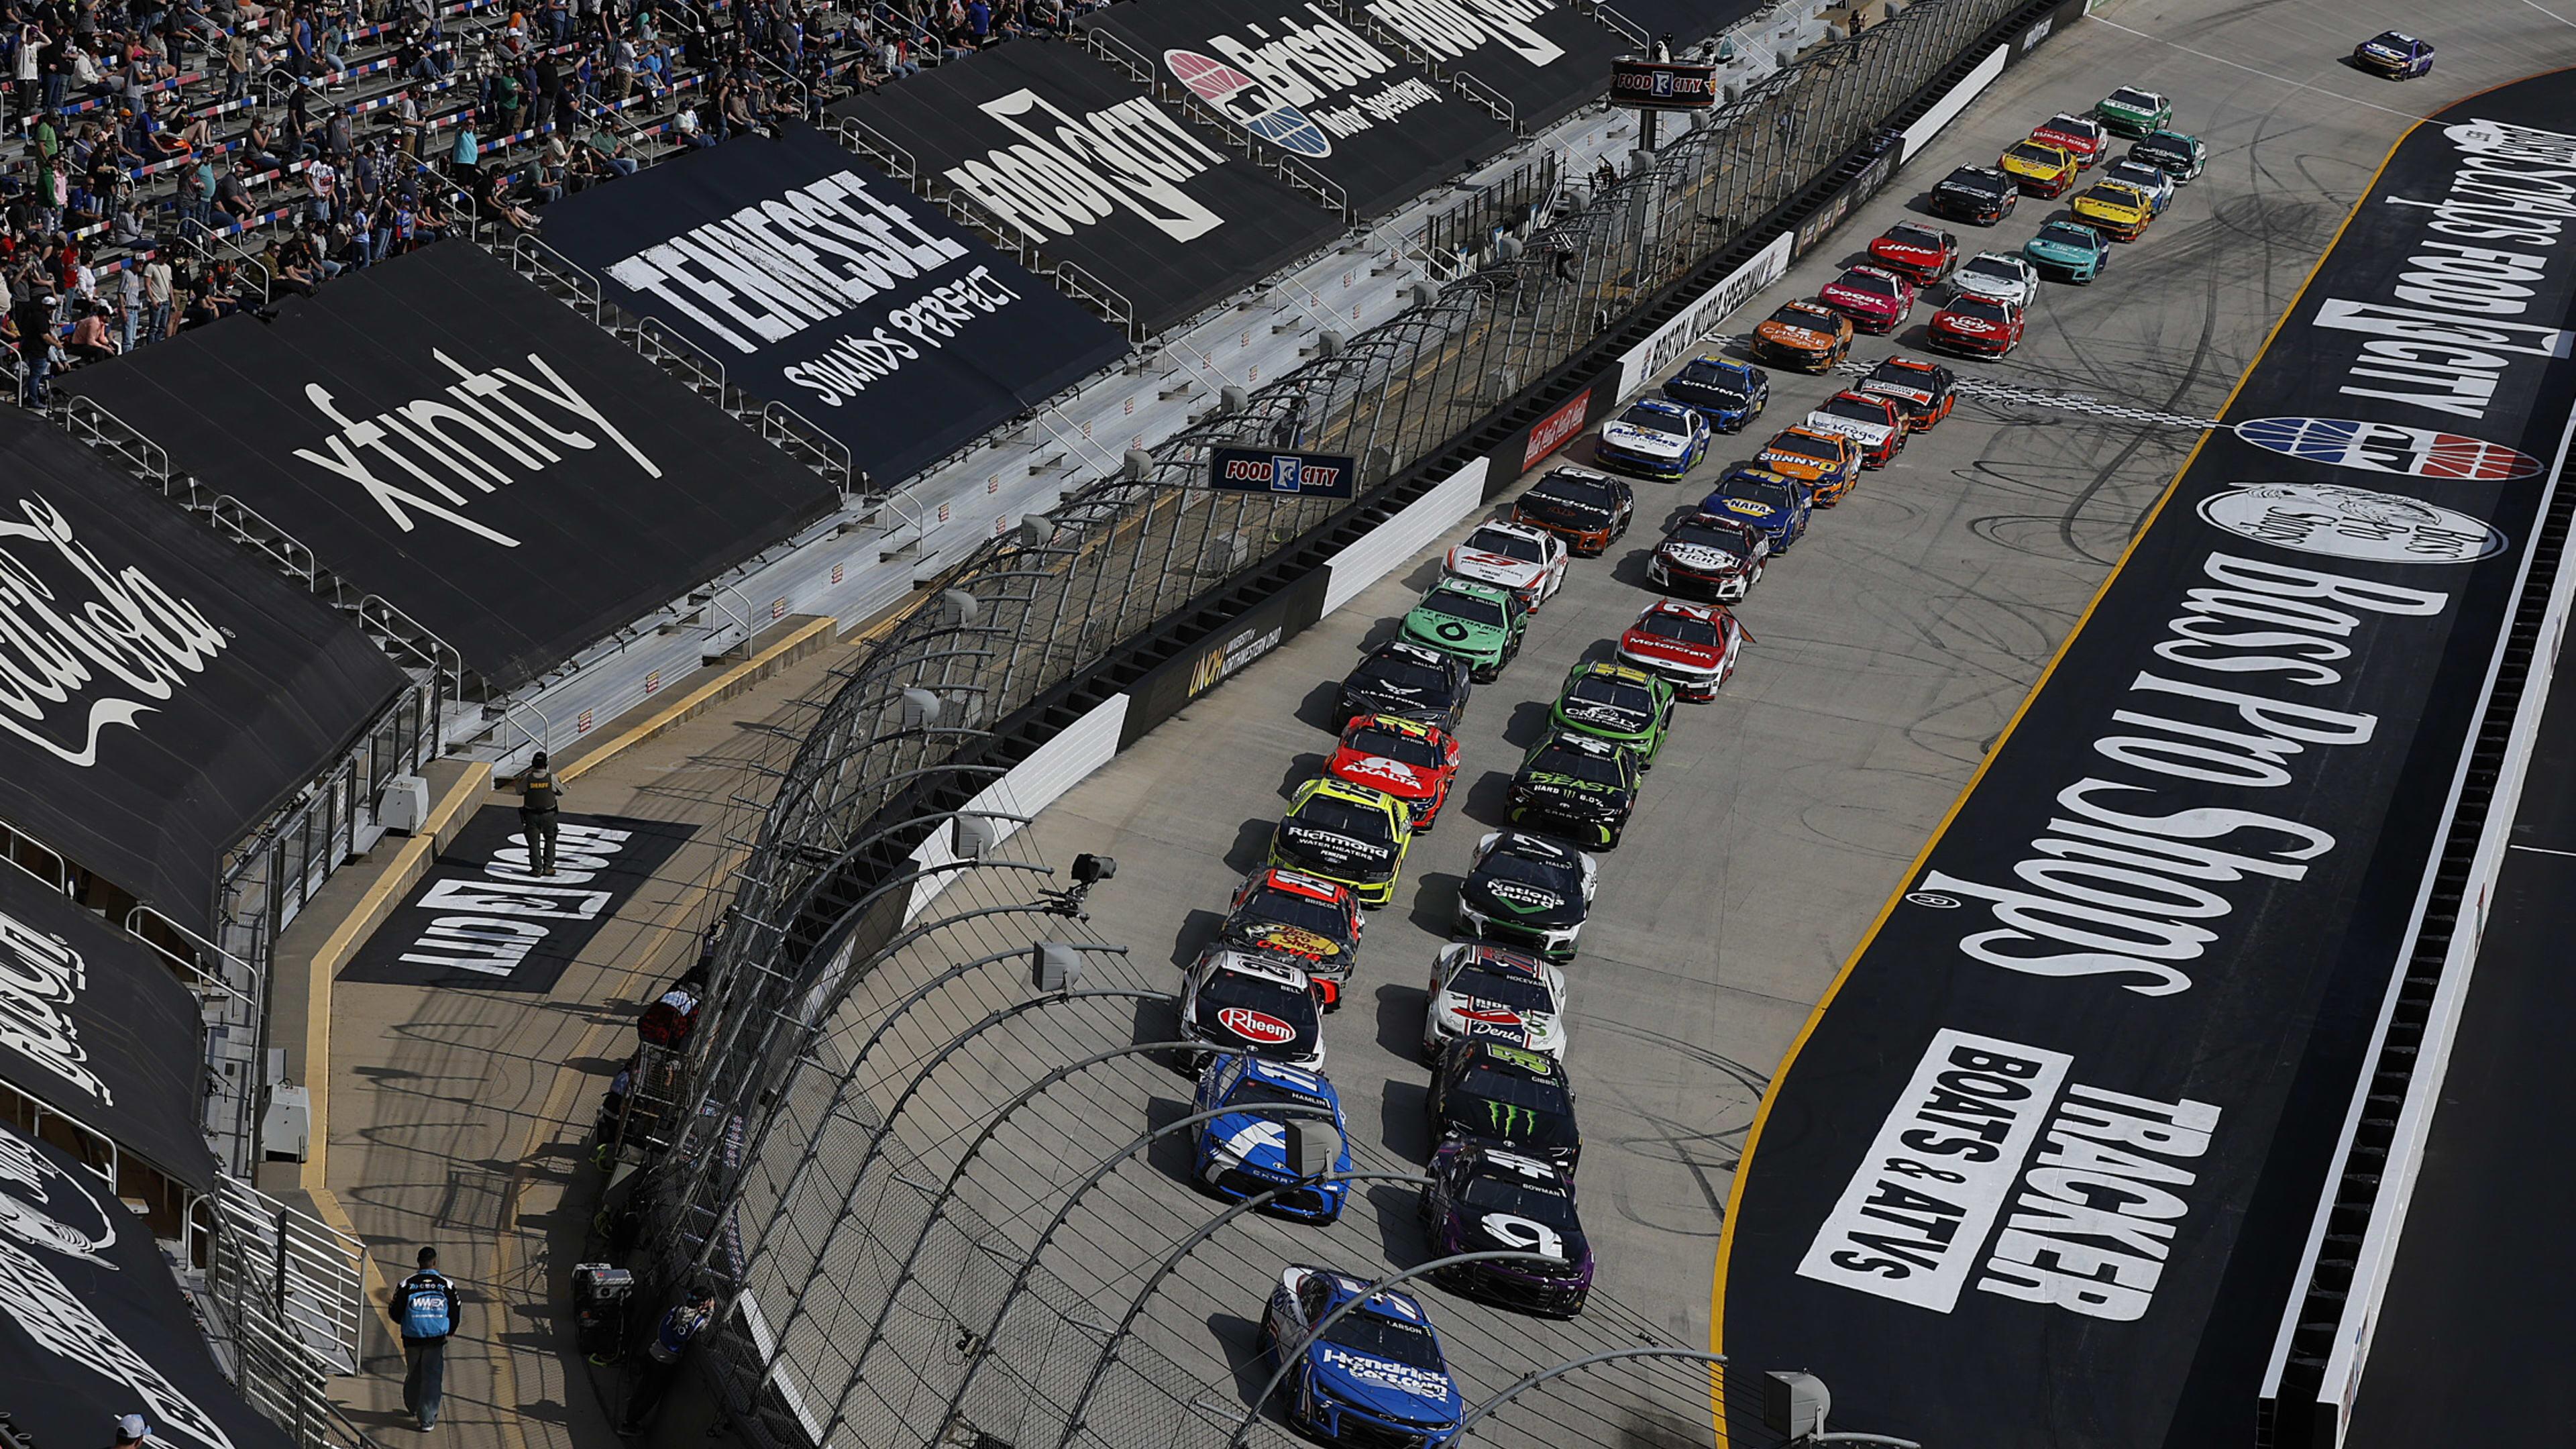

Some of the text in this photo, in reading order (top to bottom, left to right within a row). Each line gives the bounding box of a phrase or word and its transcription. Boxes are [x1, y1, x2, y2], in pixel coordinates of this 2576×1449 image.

[1207, 3, 1397, 107] Bristol
[1617, 74, 1652, 89] FOOD
[1673, 78, 1703, 93] CITY
[1309, 77, 1443, 139] Motor Speedway
[943, 144, 1113, 244] FOOD
[602, 170, 970, 355] TENNESSEE
[2394, 240, 2548, 314] FOOD
[783, 265, 1022, 407] SOUNDS PERFECT
[1762, 326, 1825, 347] CHOICE
[1680, 379, 1747, 400] OKUMA
[2339, 341, 2510, 419] CITY
[1832, 422, 1883, 443] Kroger
[292, 347, 663, 547] xfinity
[1226, 460, 1272, 481] FOOD
[1301, 466, 1339, 486] CITY
[1729, 498, 1770, 515] NAPA
[1629, 637, 1713, 660] Motorcraft
[1342, 762, 1422, 790] AXALTA
[1529, 771, 1625, 795] BEAST
[1918, 551, 2449, 998] Bass Pro Shops
[1534, 784, 1560, 794] HARD
[1288, 826, 1389, 859] Richmond
[1298, 838, 1374, 861] WATER HEATERS
[1304, 898, 1338, 910] BRISCOE
[1487, 879, 1565, 907] Nations
[1491, 888, 1554, 910] Guard
[398, 916, 550, 977] CITY
[1256, 939, 1321, 961] CLUB
[1281, 984, 1301, 995] BELL
[1476, 998, 1511, 1010] RIDE
[1228, 1009, 1291, 1039] Rheem
[1473, 1020, 1523, 1042] Dente
[1291, 1092, 1326, 1106] HAMLIN
[1900, 1045, 2042, 1163] BOATS
[1884, 1158, 1966, 1185] &
[1522, 1183, 1560, 1197] BOWMAN
[1977, 1083, 2222, 1321] TRACKER
[1387, 1319, 1422, 1336] LARSON
